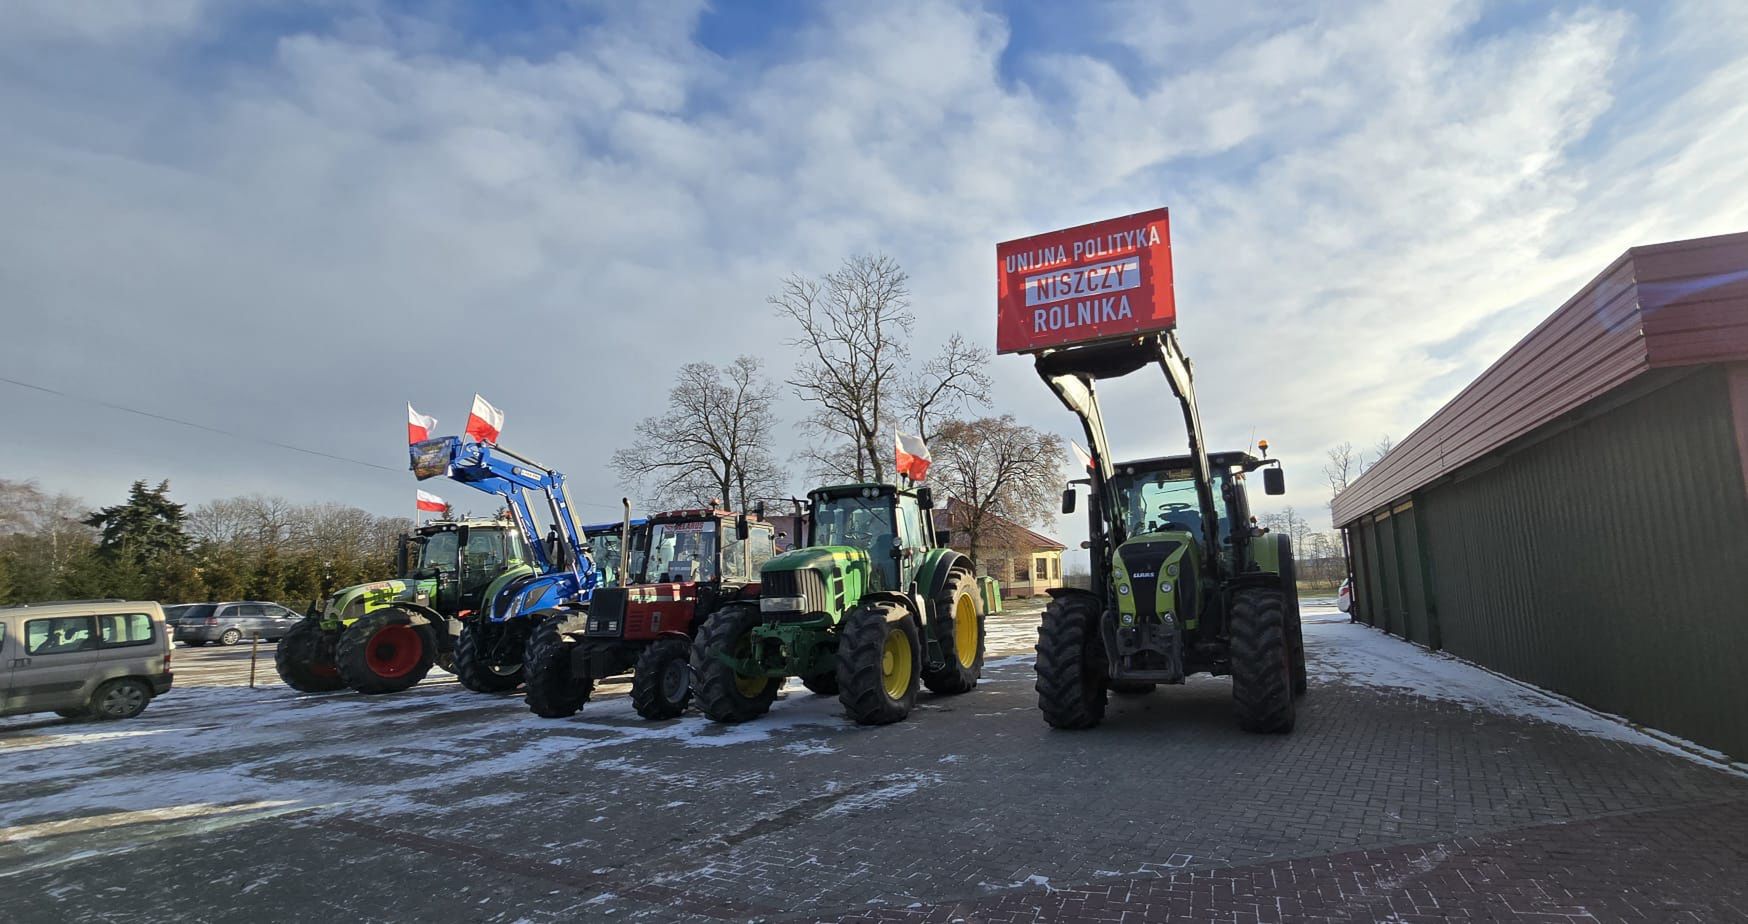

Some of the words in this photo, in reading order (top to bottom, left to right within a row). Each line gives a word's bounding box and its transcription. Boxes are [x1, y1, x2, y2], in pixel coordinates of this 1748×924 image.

[1006, 245, 1067, 273] UNIJNA
[1073, 225, 1161, 261] POLITYKA
[1037, 262, 1126, 300] NISZCZY
[1034, 295, 1133, 333] ROLNIKA
